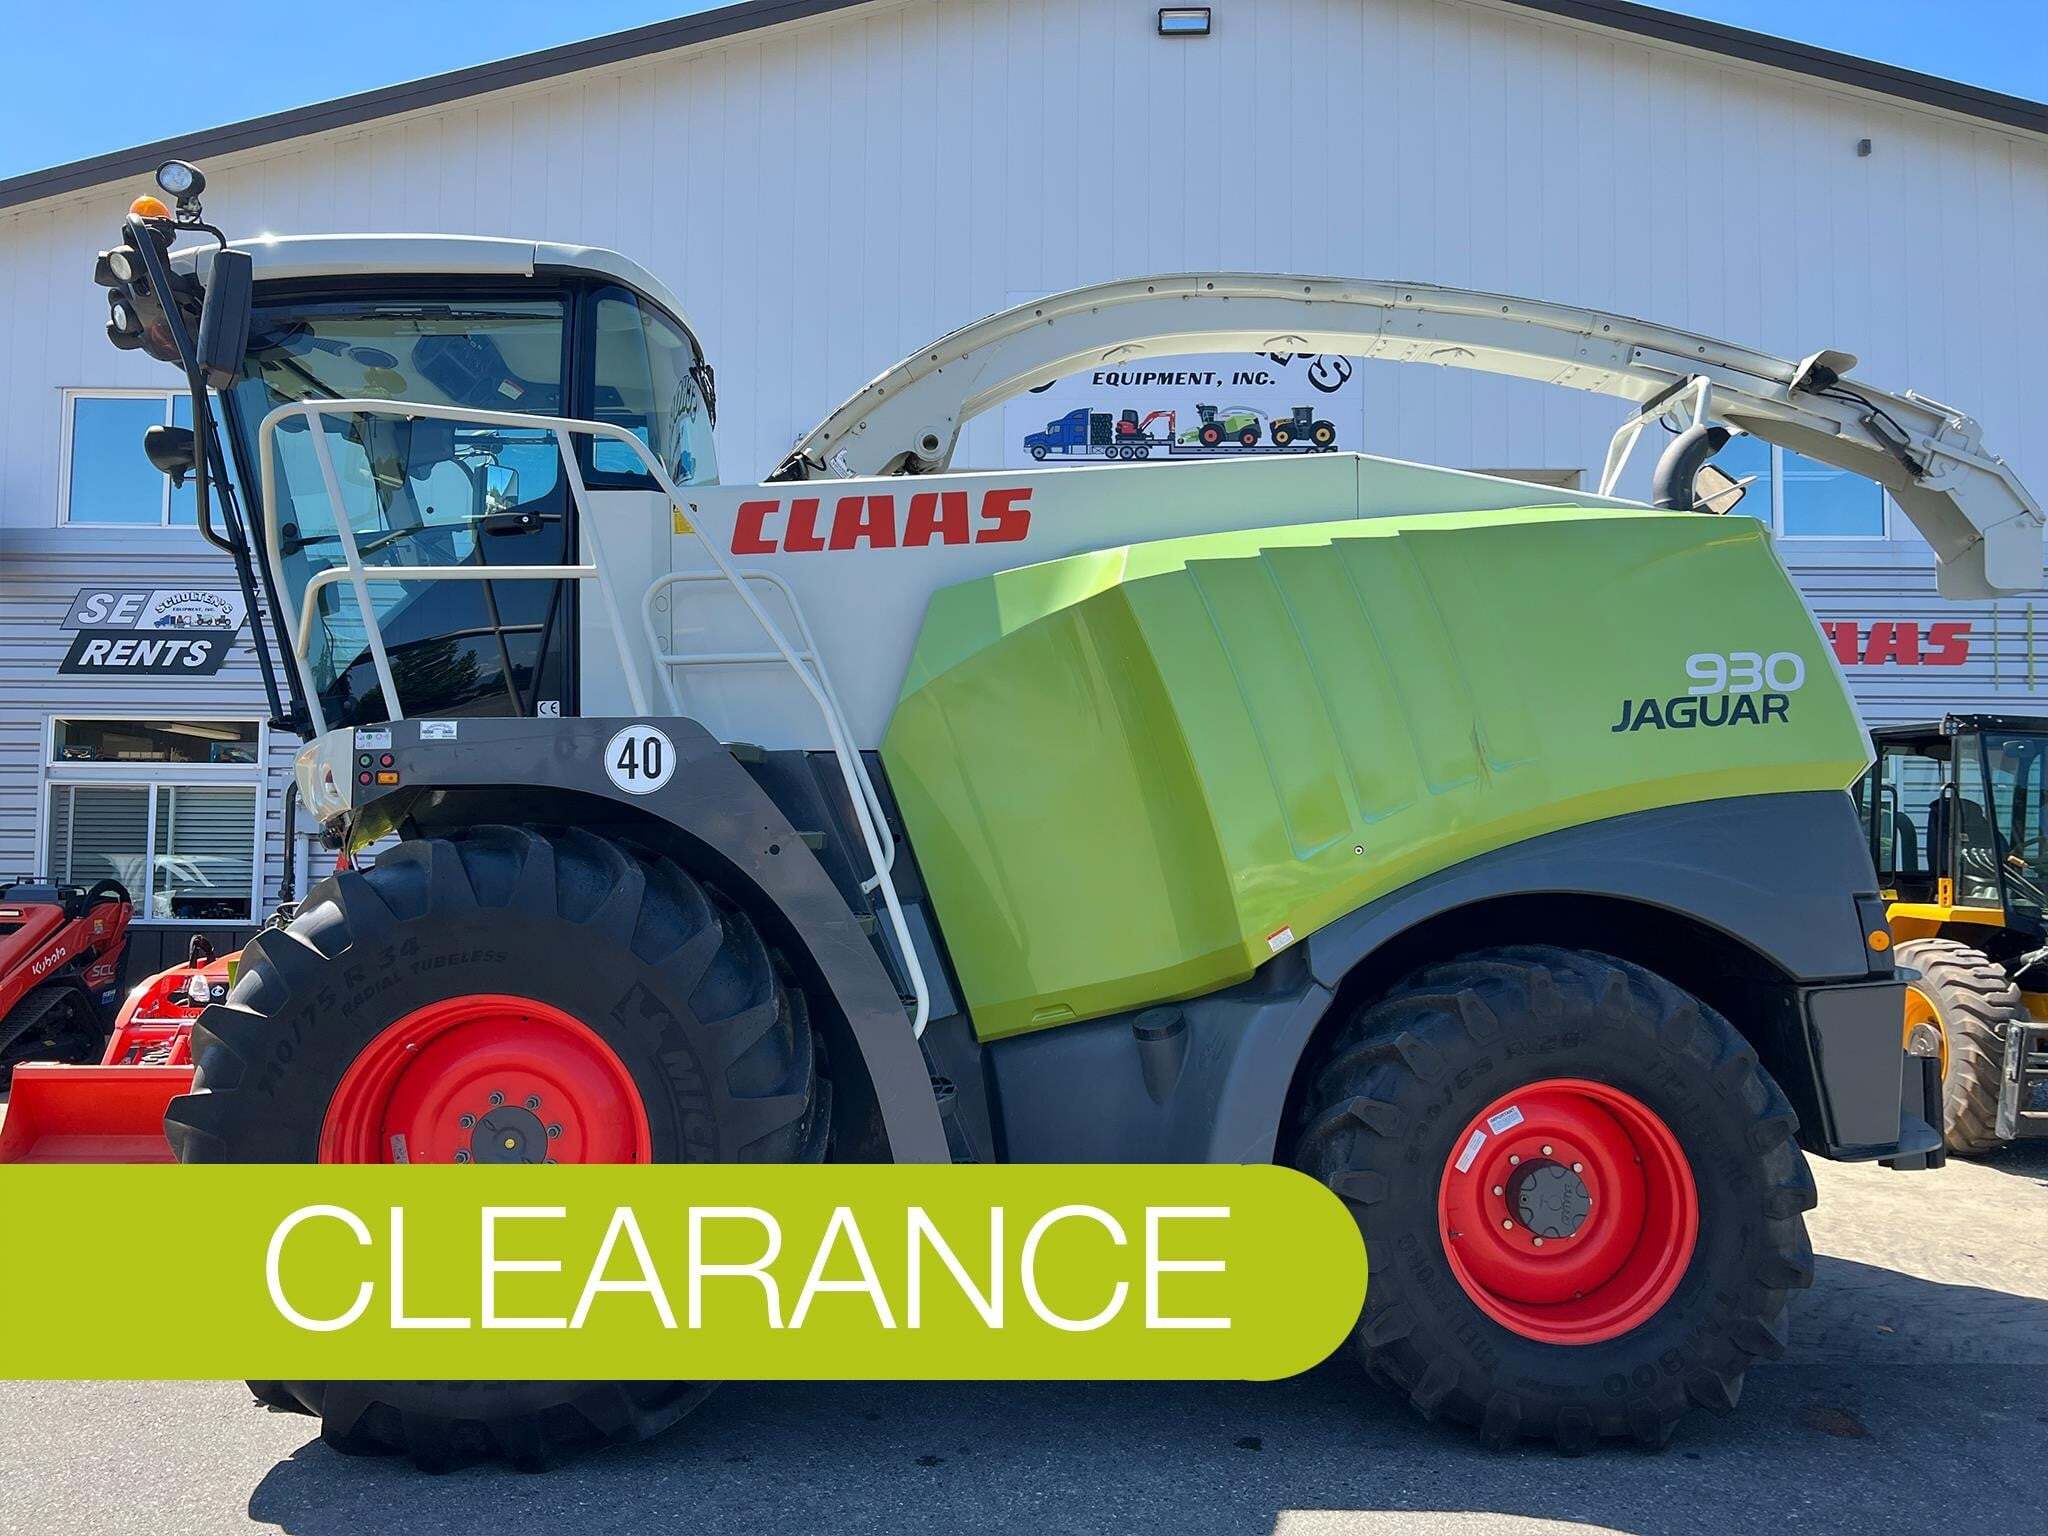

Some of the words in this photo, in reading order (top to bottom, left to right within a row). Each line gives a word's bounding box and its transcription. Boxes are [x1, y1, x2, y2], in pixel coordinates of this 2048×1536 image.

[1092, 371, 1223, 388] EQUIPMENT,
[1232, 371, 1276, 385] INC.
[730, 487, 1033, 556] CLAAS
[77, 593, 147, 625] SE
[155, 591, 234, 614] SCHOLTEN'S
[78, 639, 212, 668] RENTS
[1820, 622, 1972, 666] AAS
[1685, 651, 1806, 695] 930
[1611, 693, 1791, 733] JAGUAR
[617, 736, 661, 780] 40
[31, 946, 67, 975] Kubota
[91, 964, 115, 978] SCL
